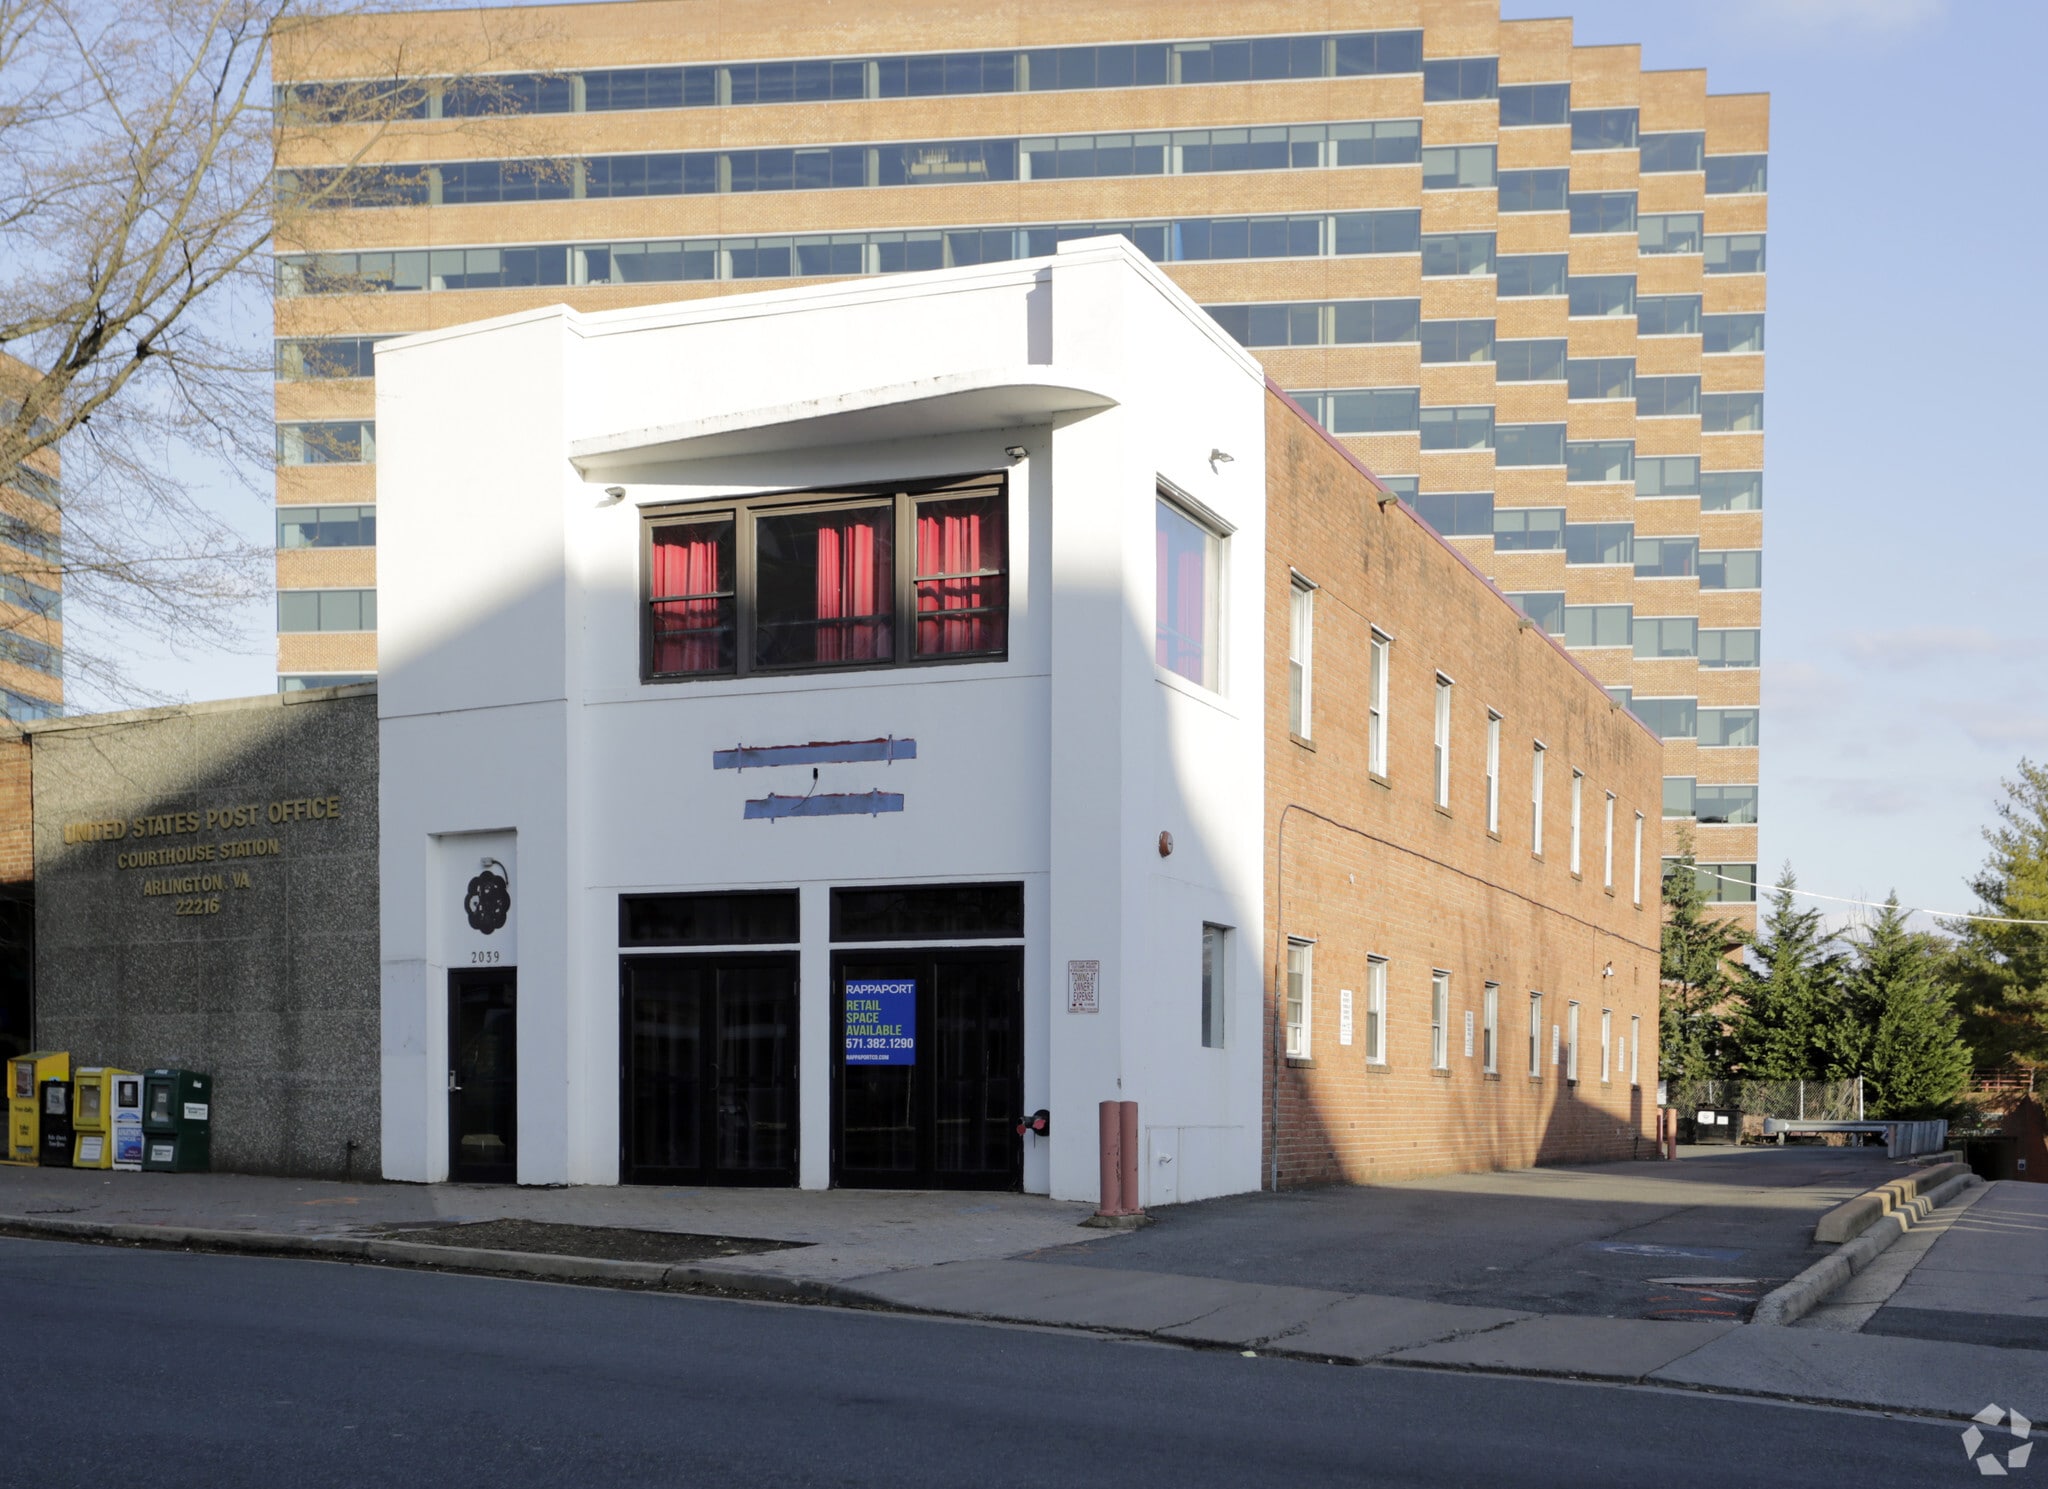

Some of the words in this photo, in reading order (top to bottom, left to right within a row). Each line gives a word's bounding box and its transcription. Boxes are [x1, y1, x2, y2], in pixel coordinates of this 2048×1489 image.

[64, 818, 127, 844] UNITED
[132, 811, 199, 839] STATES
[206, 804, 260, 830] POST
[268, 796, 340, 824] OFFICE
[118, 846, 215, 868] COURTHOUSE
[220, 838, 278, 859] STATION
[233, 872, 250, 888] VA
[175, 898, 220, 915] 22216
[471, 951, 500, 963] 2039
[846, 984, 914, 994] RAPPAPORT
[846, 1000, 881, 1011] RETAIL
[846, 1012, 879, 1023] SPACE
[846, 1024, 902, 1036] AVAILABLE
[845, 1038, 914, 1049] 571.382.1290
